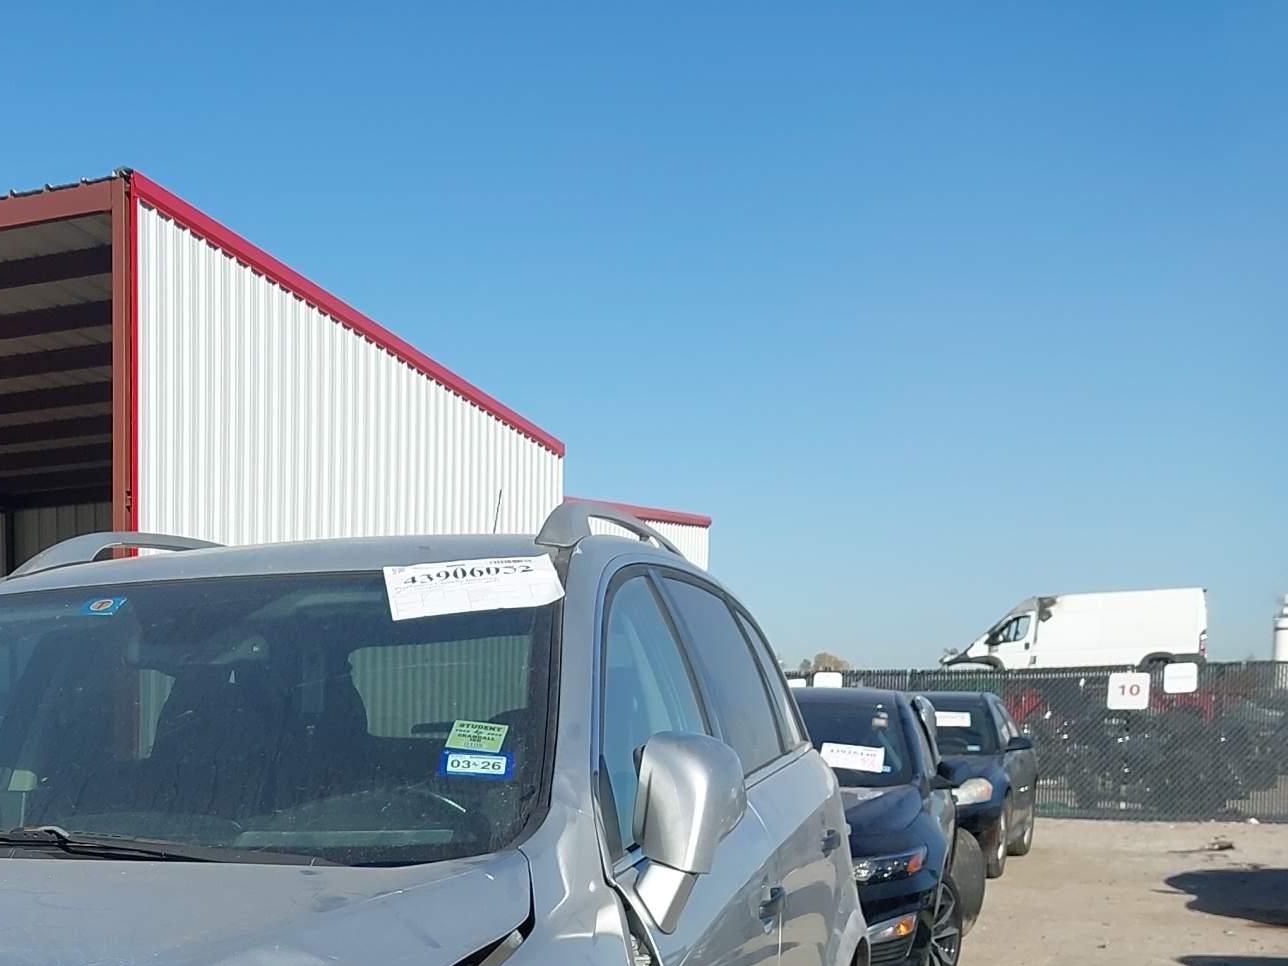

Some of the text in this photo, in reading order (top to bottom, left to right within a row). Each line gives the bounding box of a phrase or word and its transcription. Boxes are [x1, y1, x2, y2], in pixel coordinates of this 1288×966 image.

[403, 564, 535, 585] 43906052
[1118, 684, 1141, 696] 10
[459, 723, 503, 732] STUDENT
